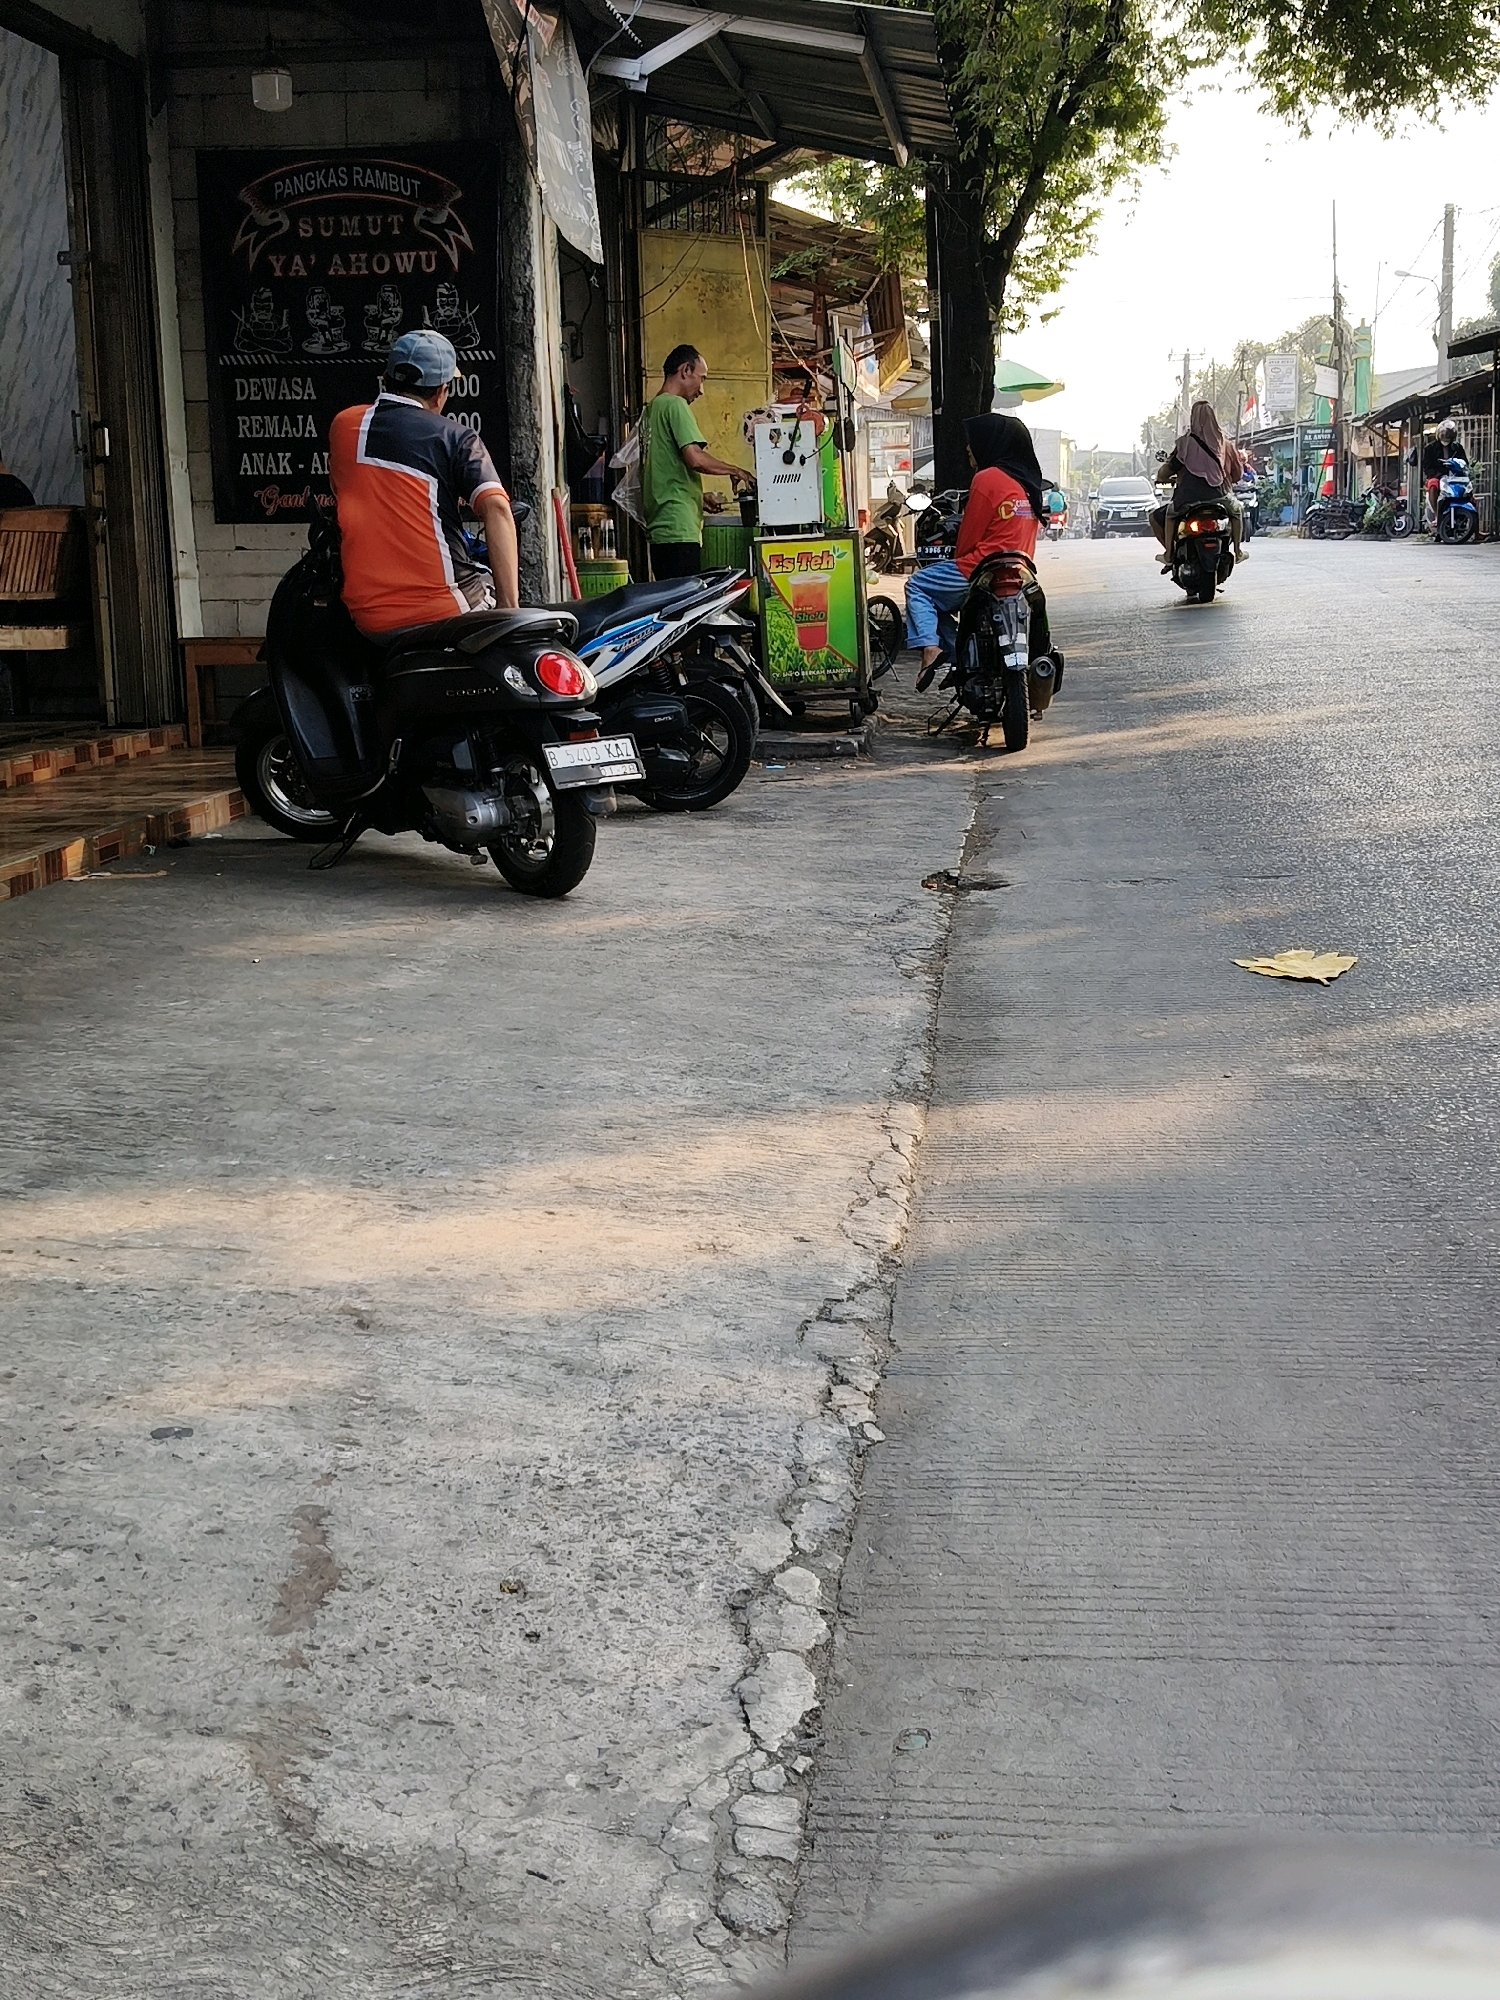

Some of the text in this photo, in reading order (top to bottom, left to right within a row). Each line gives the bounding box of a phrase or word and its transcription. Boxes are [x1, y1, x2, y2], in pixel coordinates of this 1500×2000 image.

[274, 166, 421, 200] PANGKAS RAMBUT
[298, 214, 404, 238] SUMUT
[328, 250, 438, 276] AHOWU
[235, 377, 317, 402] DEWASA
[237, 415, 318, 438] REMAJA
[239, 452, 293, 475] ANAK
[769, 550, 835, 574] Es Teh
[548, 742, 632, 767] B 5403 KAZ
